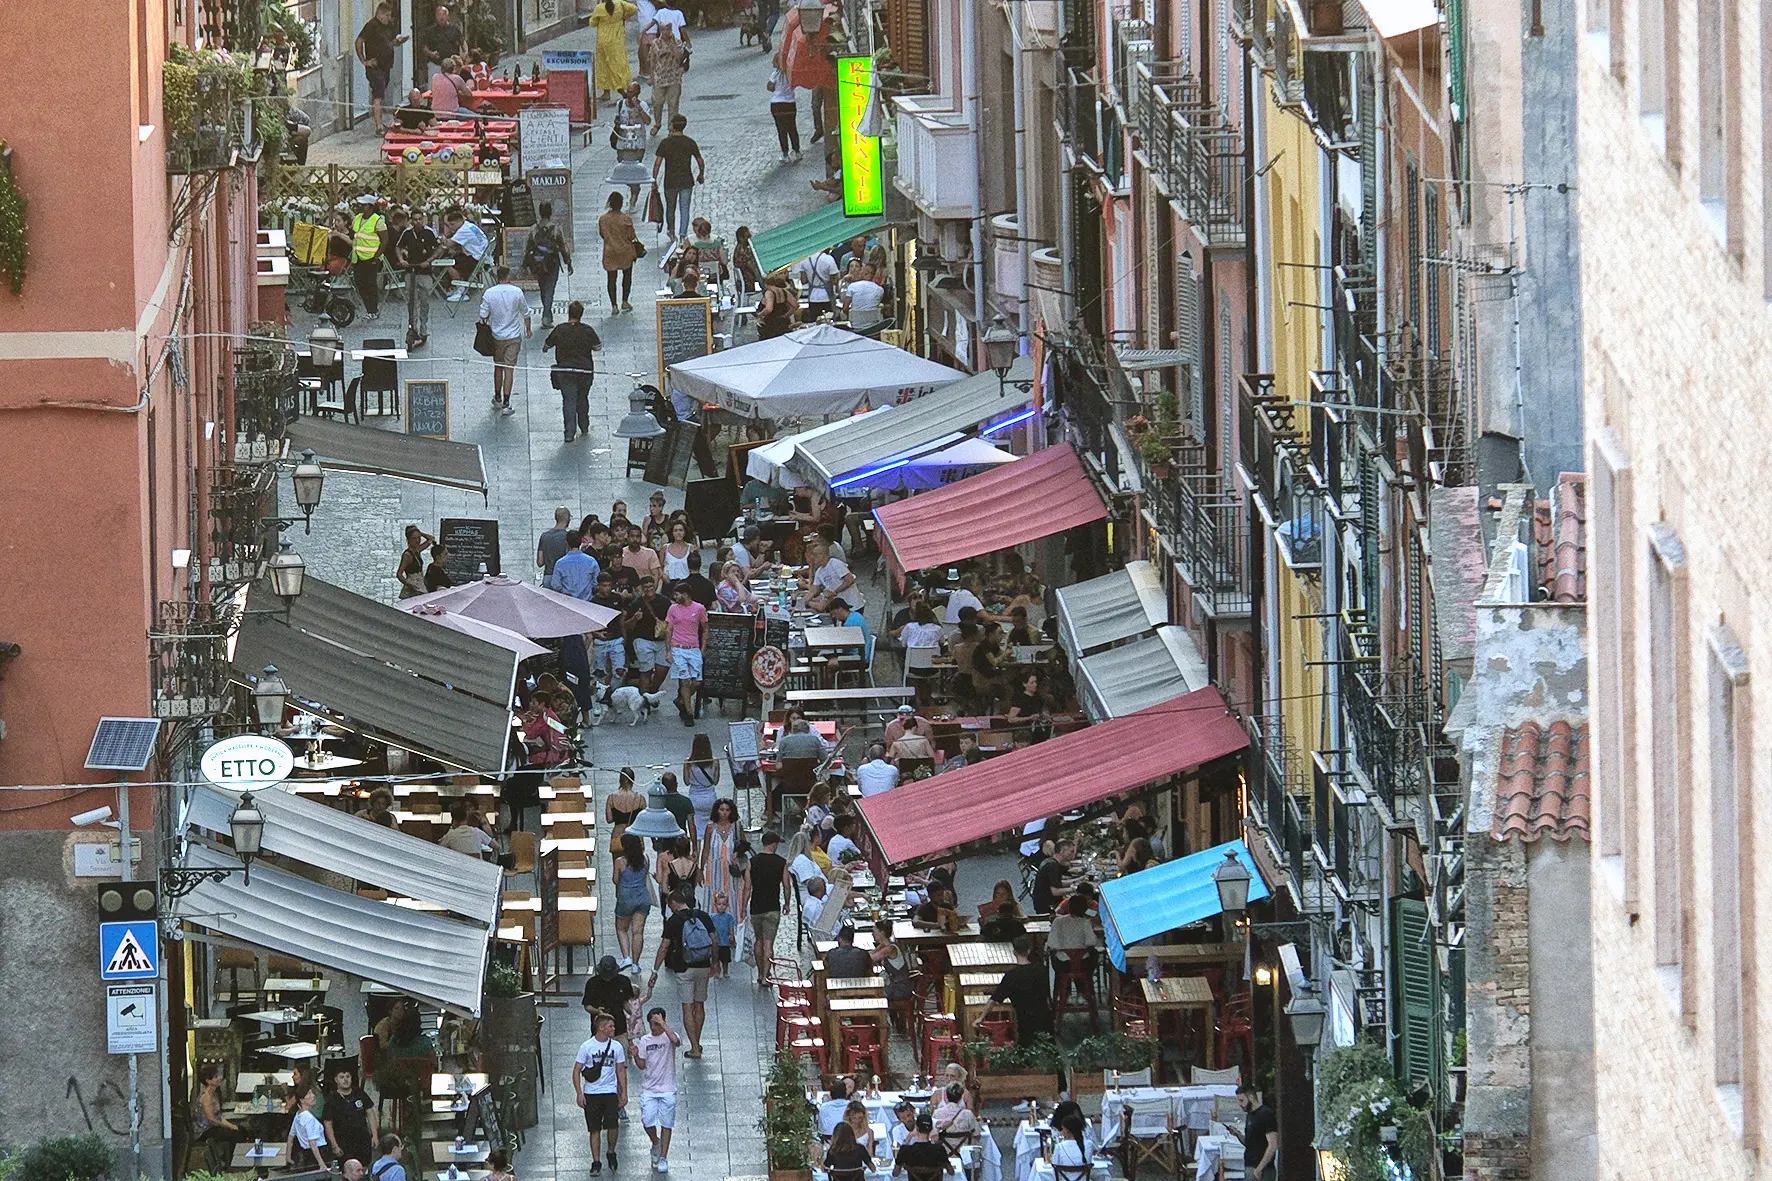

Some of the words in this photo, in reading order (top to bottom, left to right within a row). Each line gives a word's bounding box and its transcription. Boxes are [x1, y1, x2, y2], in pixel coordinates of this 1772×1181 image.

[522, 134, 564, 144] CLIENTI
[531, 176, 567, 186] MAKLAD
[412, 396, 446, 406] KEBAB
[412, 420, 443, 433] NUOVO
[221, 758, 276, 778] ETTO
[111, 987, 151, 995] ATTENZIONE!
